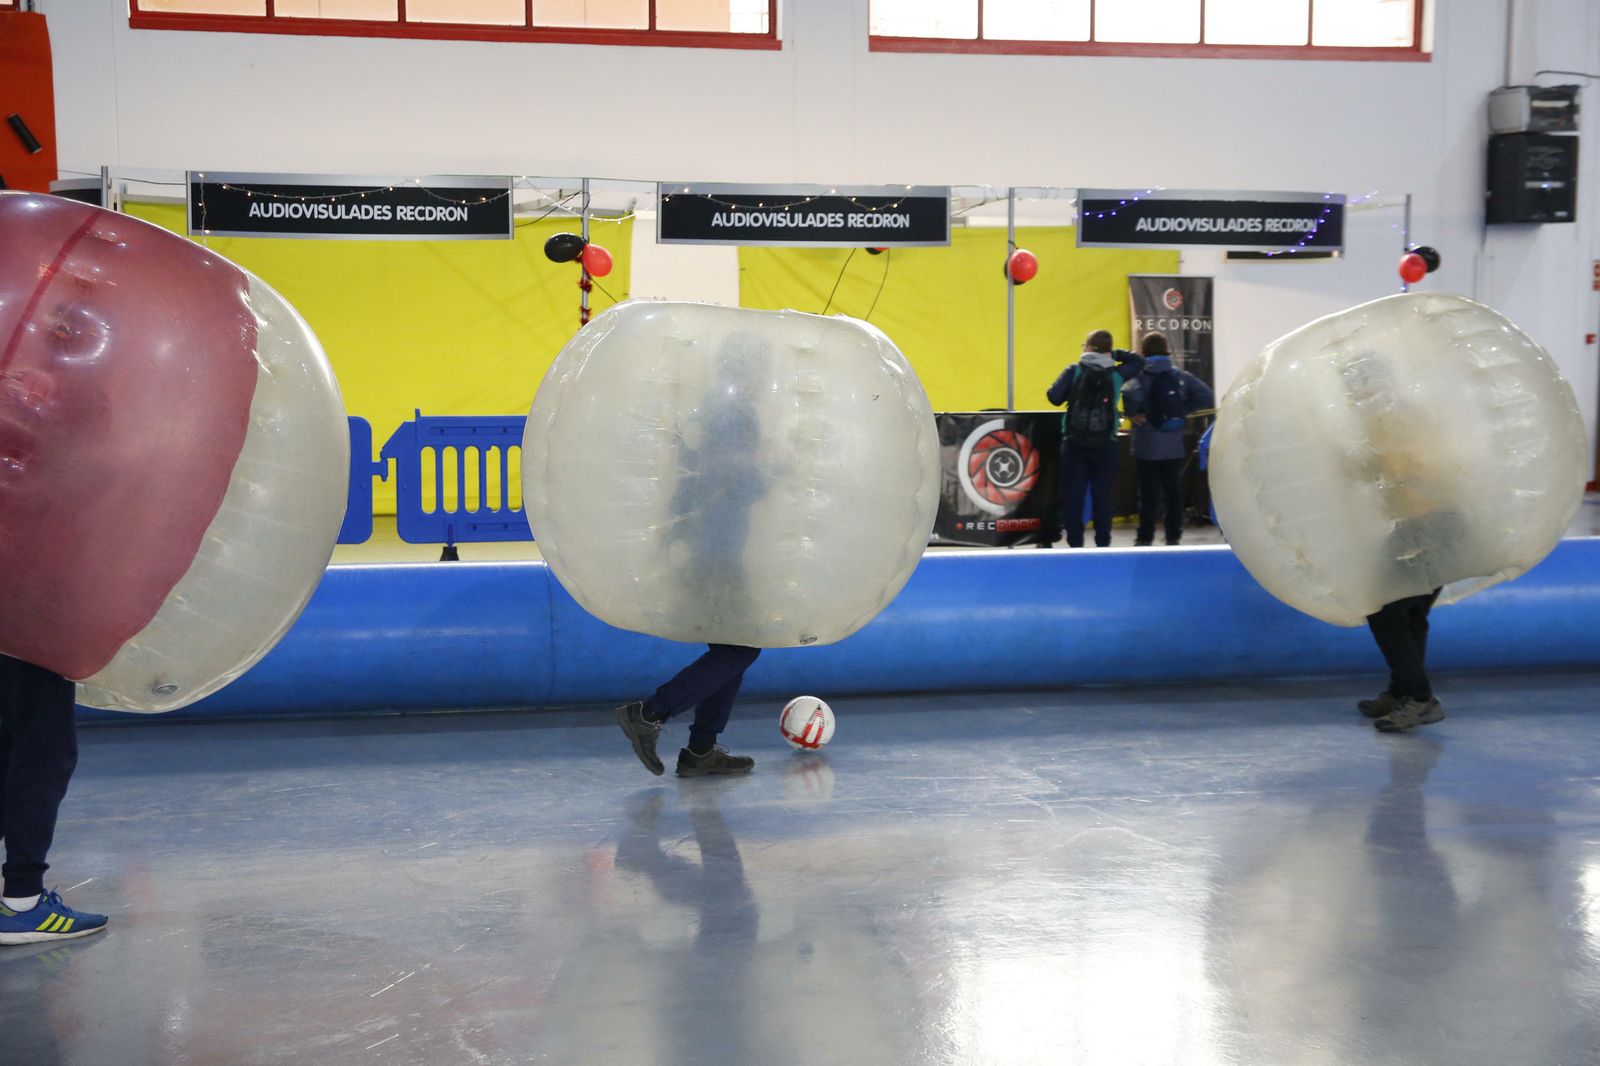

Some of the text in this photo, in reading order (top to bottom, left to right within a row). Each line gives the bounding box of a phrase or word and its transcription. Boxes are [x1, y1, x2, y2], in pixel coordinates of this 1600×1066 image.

[248, 201, 468, 222] AUDIOVISULADES RECDRON
[711, 212, 910, 229] AUDIOVISULADES RECDRON
[1135, 217, 1318, 234] AUDIOVISULADES RECDRON
[1135, 318, 1212, 331] RECDRON
